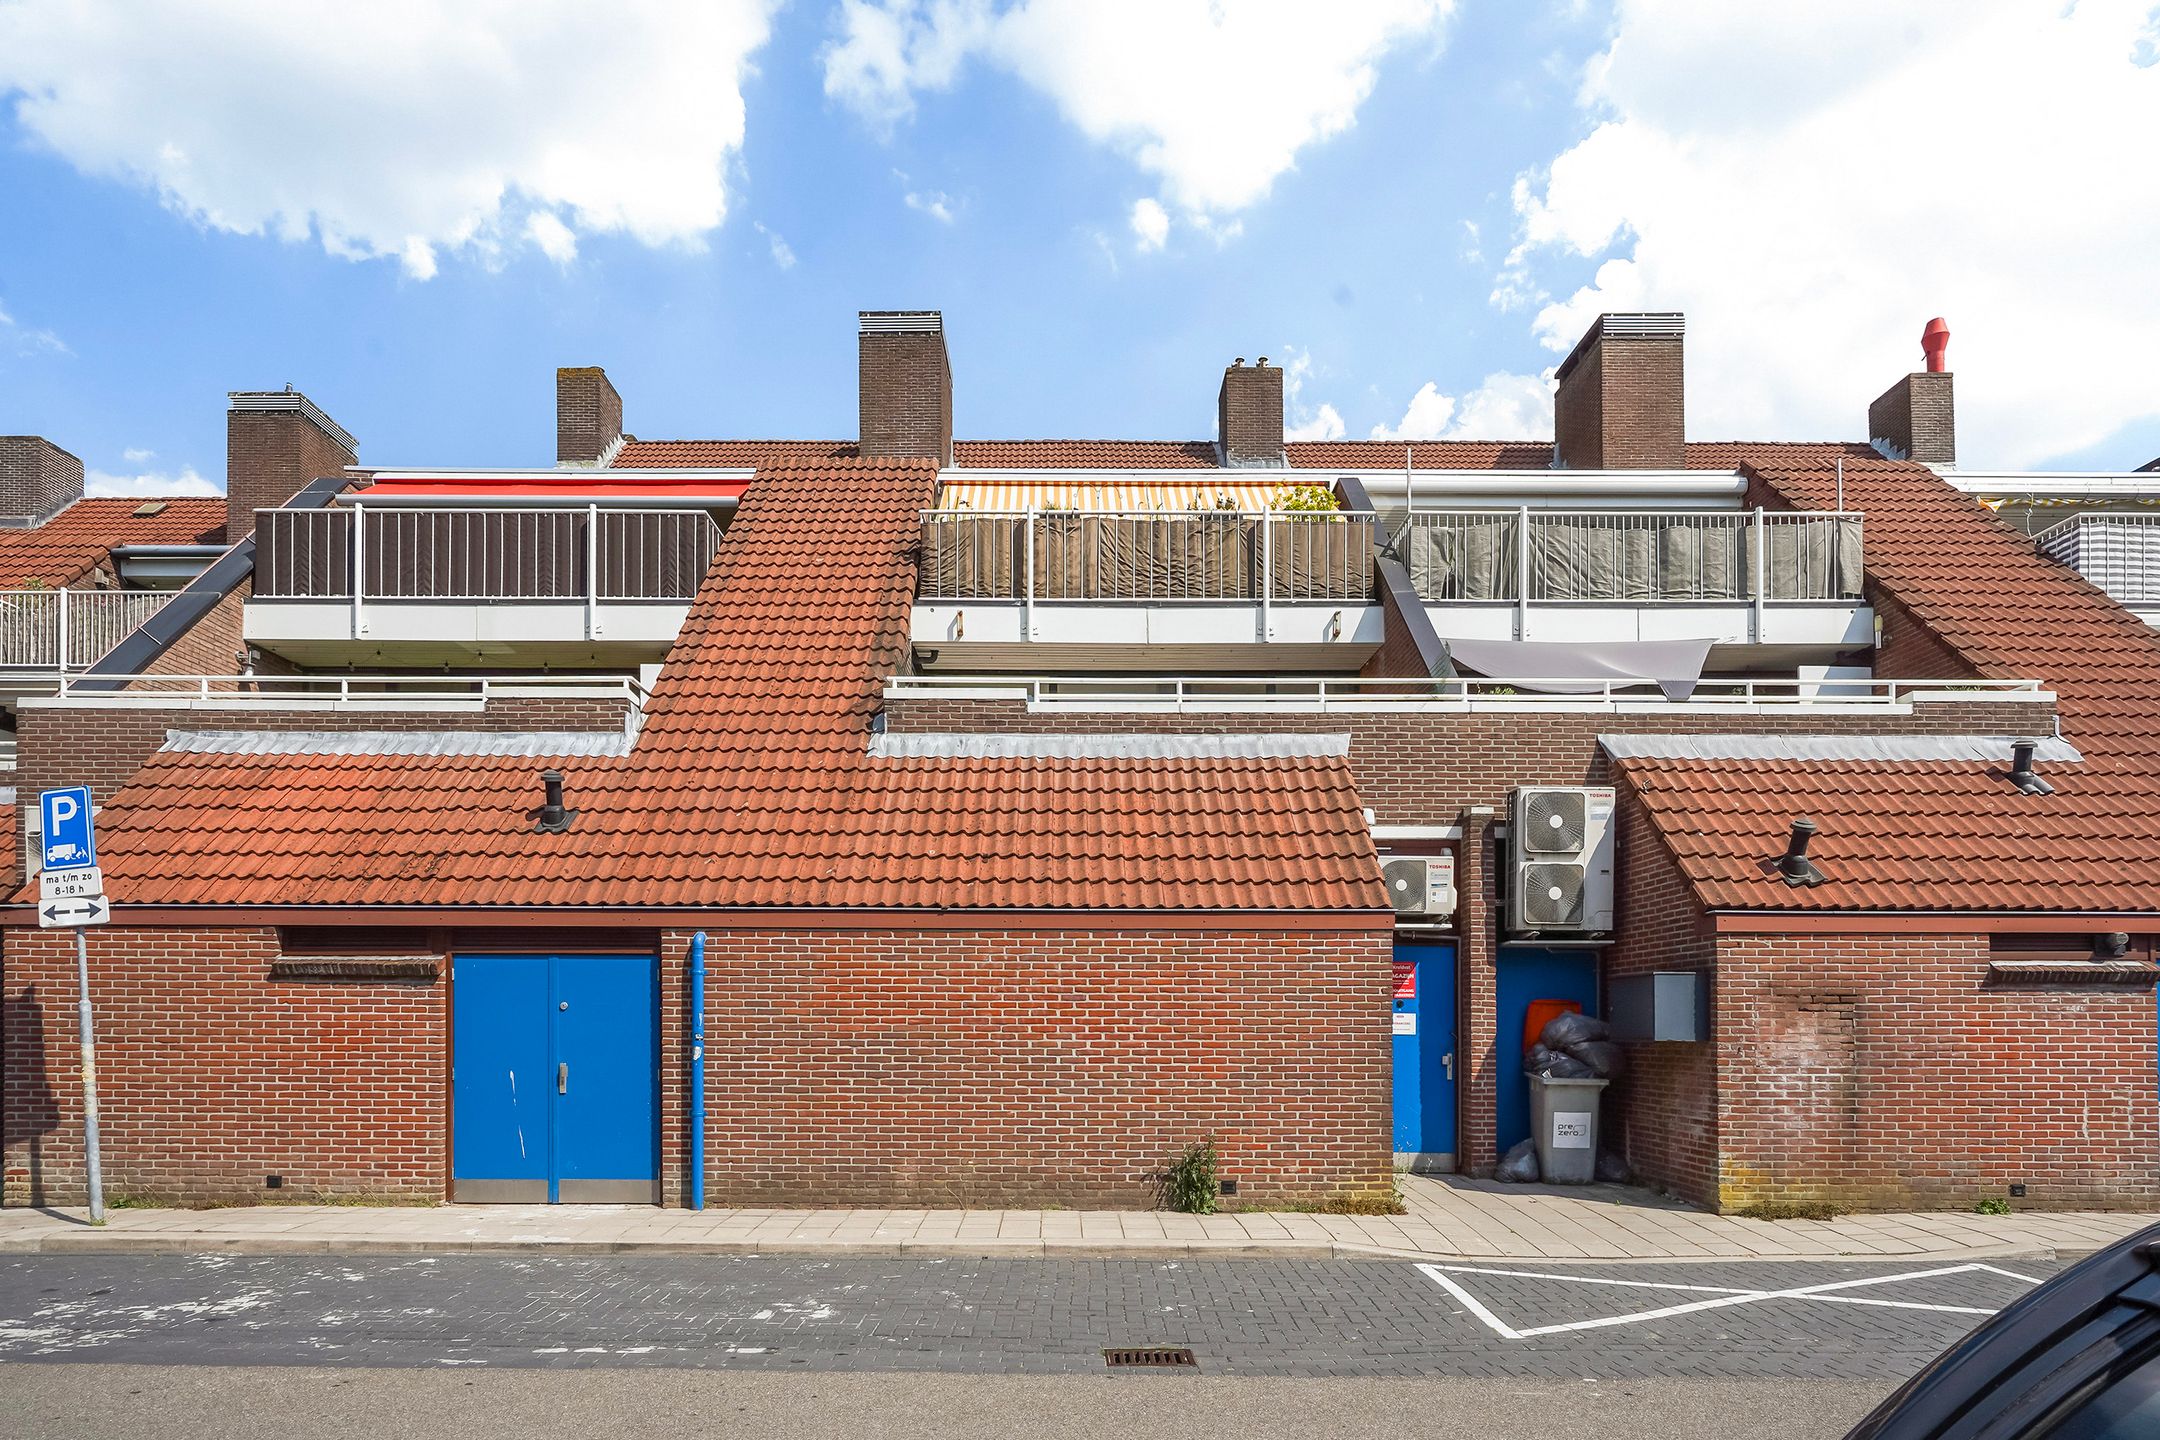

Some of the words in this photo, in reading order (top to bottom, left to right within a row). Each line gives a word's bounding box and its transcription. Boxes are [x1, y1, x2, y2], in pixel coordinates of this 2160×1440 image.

[52, 796, 78, 836] P
[46, 876, 59, 884] ma
[62, 873, 79, 883] t/m
[55, 886, 75, 895] 8-18
[79, 885, 84, 893] h
